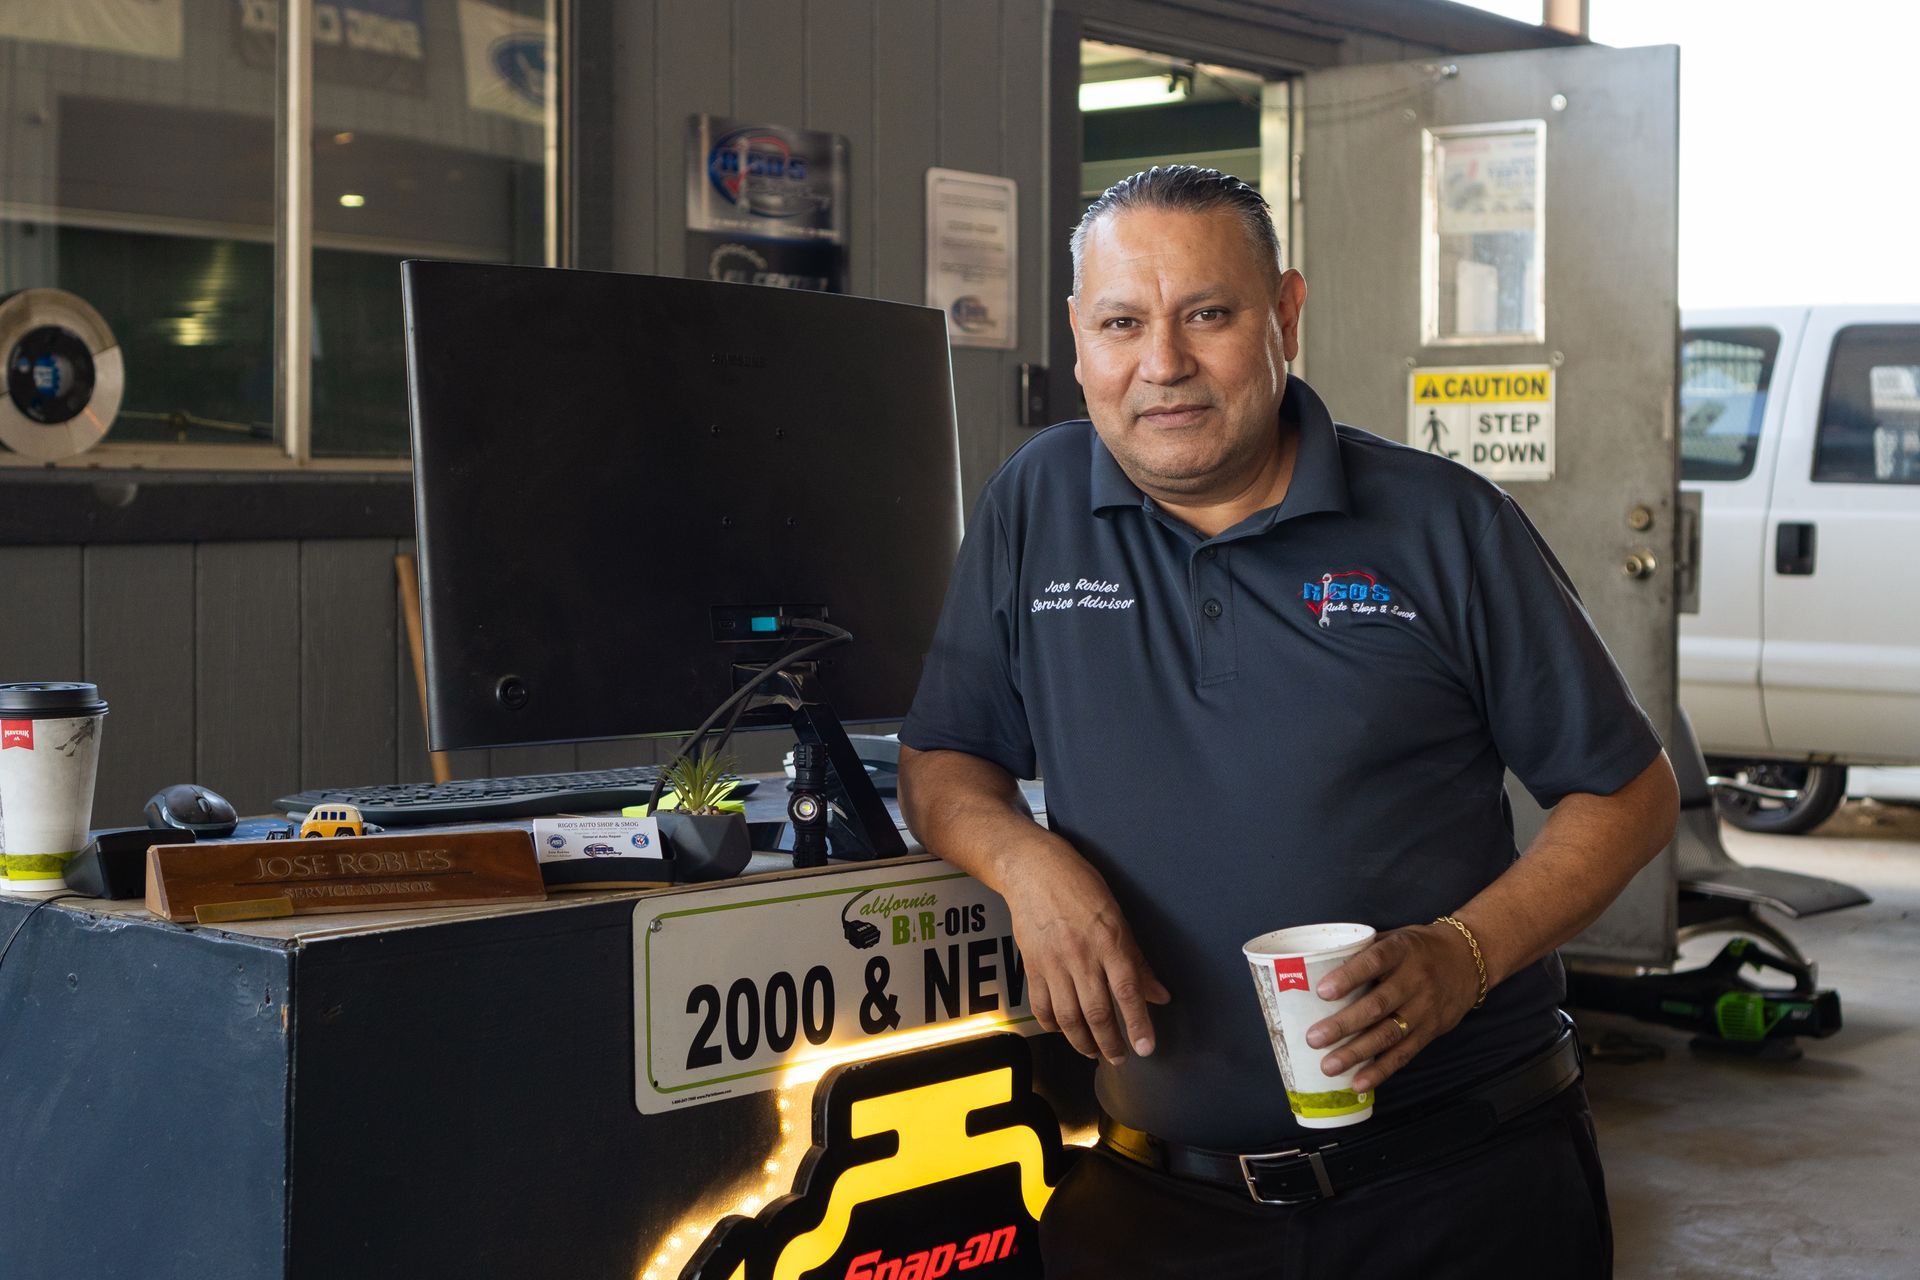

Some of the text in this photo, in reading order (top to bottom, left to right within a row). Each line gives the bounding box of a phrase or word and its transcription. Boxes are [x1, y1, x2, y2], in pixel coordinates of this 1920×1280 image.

[1444, 376, 1546, 397] CAUTION
[1479, 413, 1540, 433] STEP
[1473, 443, 1546, 463] DOWN
[1044, 578, 1120, 593] Jose Robles
[1031, 595, 1135, 613] Service Advisor
[1324, 602, 1417, 621] Auto Shop & Smog
[256, 849, 451, 880] JOSE ROBLES
[283, 880, 436, 899] SERVICE ADVISOR
[686, 965, 835, 1070] 2000
[859, 956, 901, 1035] &
[843, 1225, 1017, 1280] Snap-on
